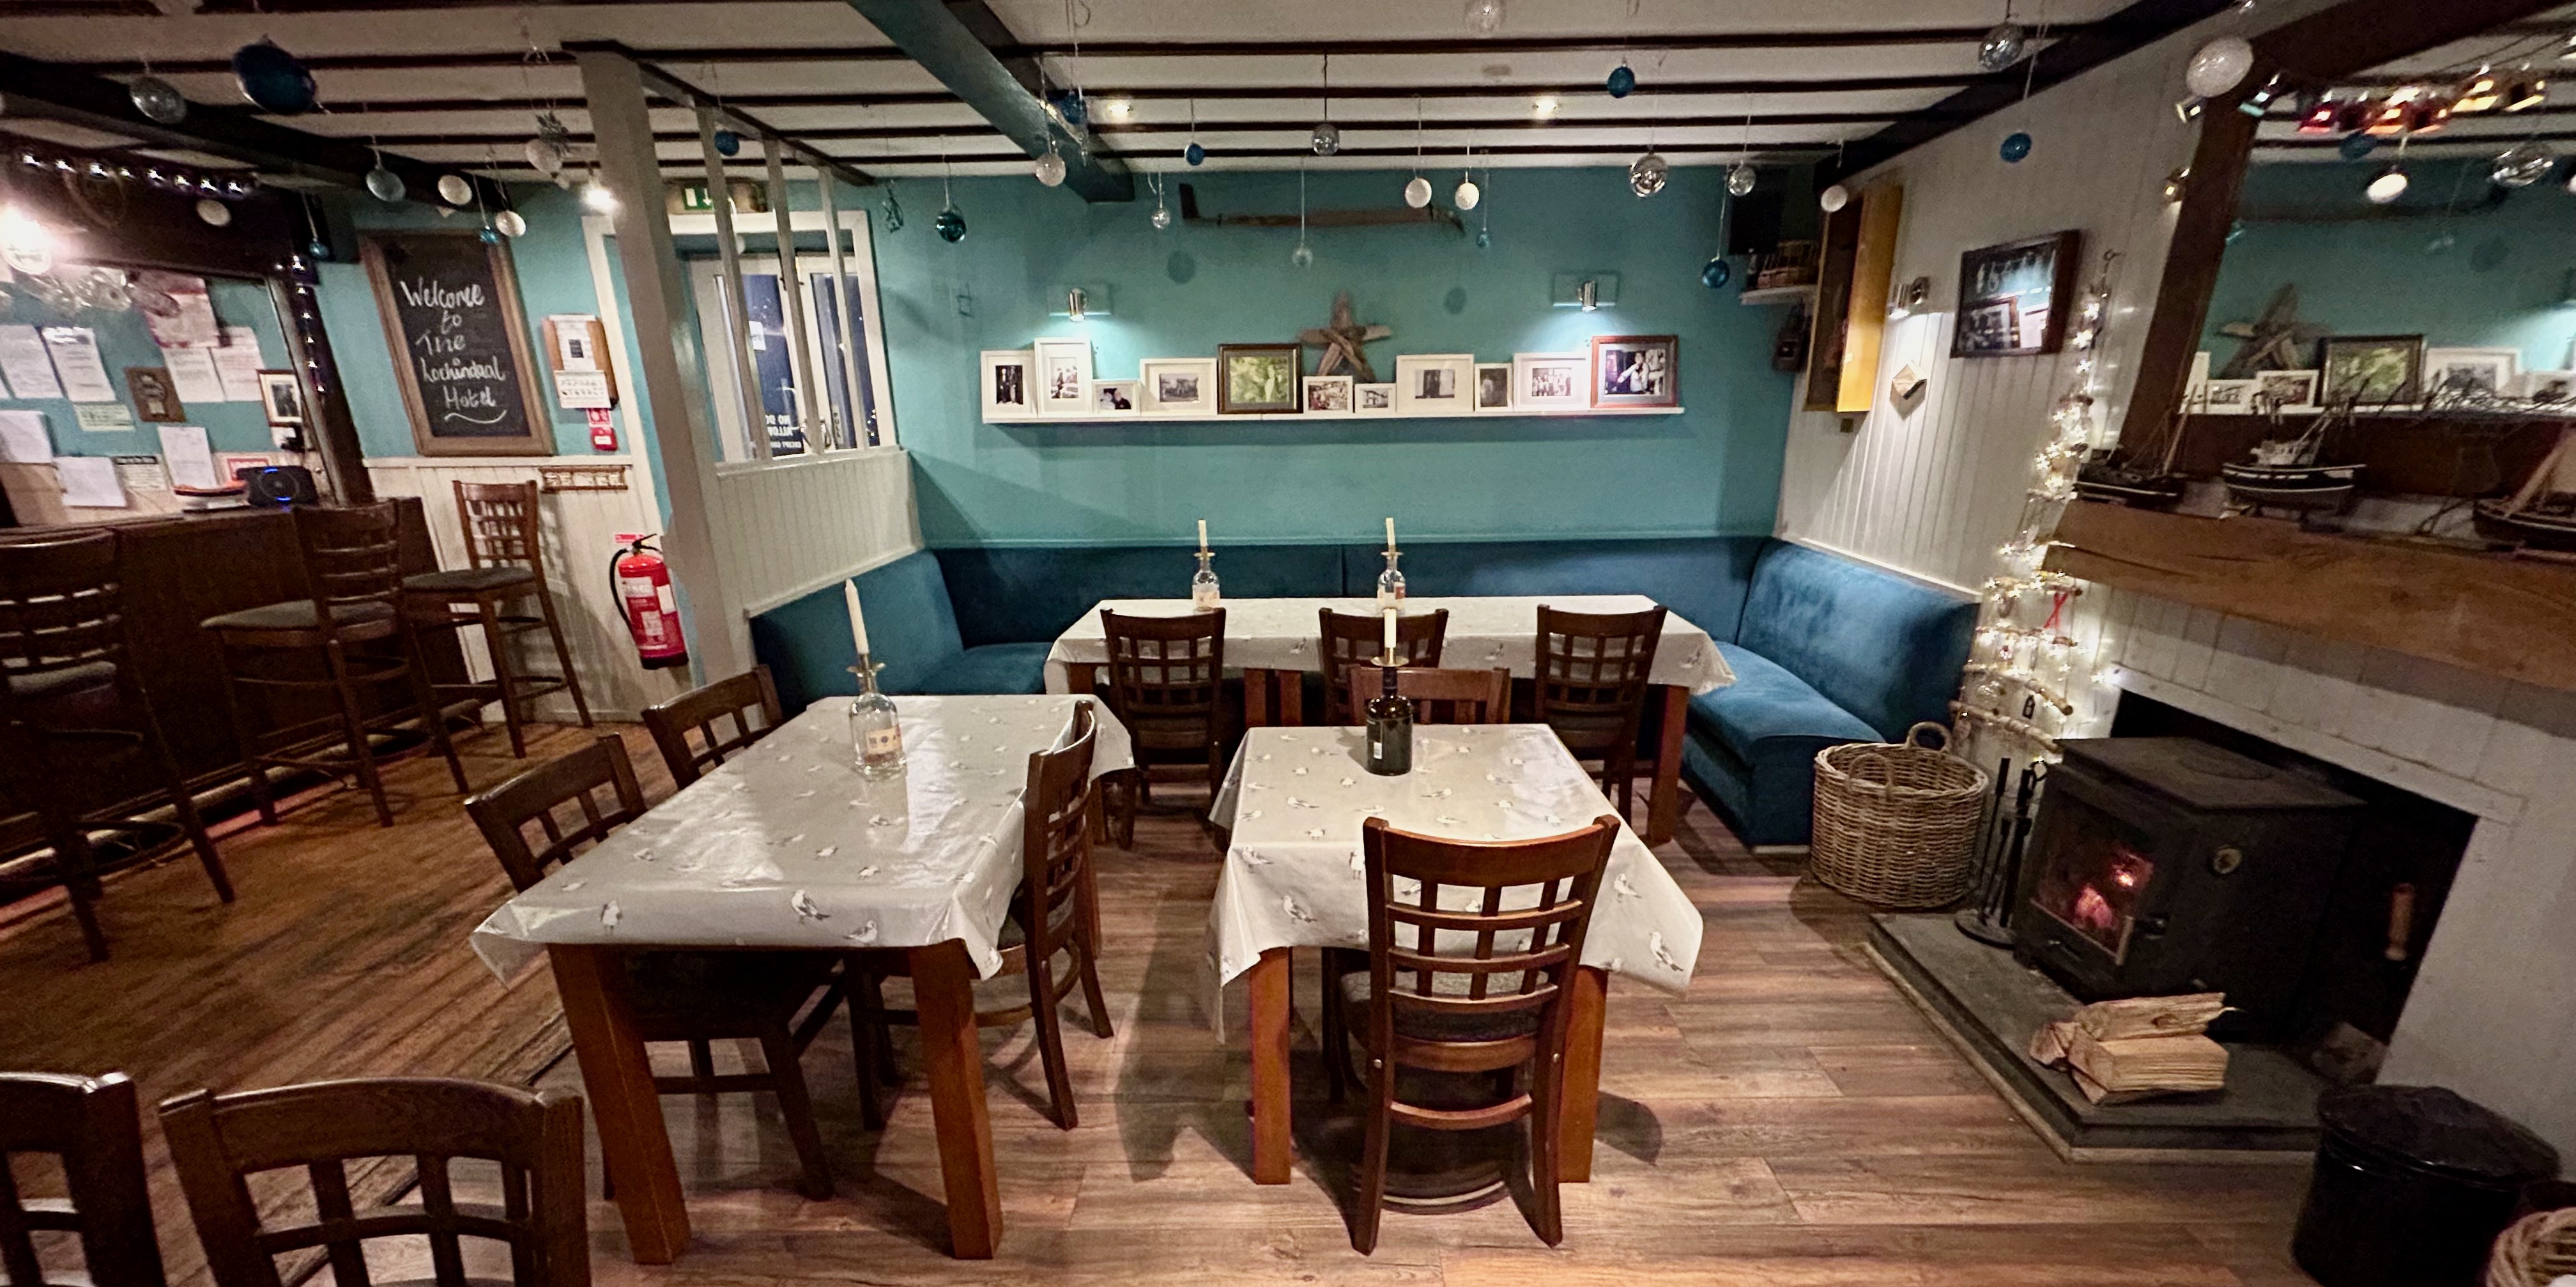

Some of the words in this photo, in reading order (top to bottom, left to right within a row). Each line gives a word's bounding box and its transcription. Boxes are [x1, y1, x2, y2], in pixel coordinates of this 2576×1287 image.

[400, 277, 485, 308] Welcome
[441, 309, 462, 335] to
[416, 328, 466, 355] The
[443, 385, 496, 410] Hotel
